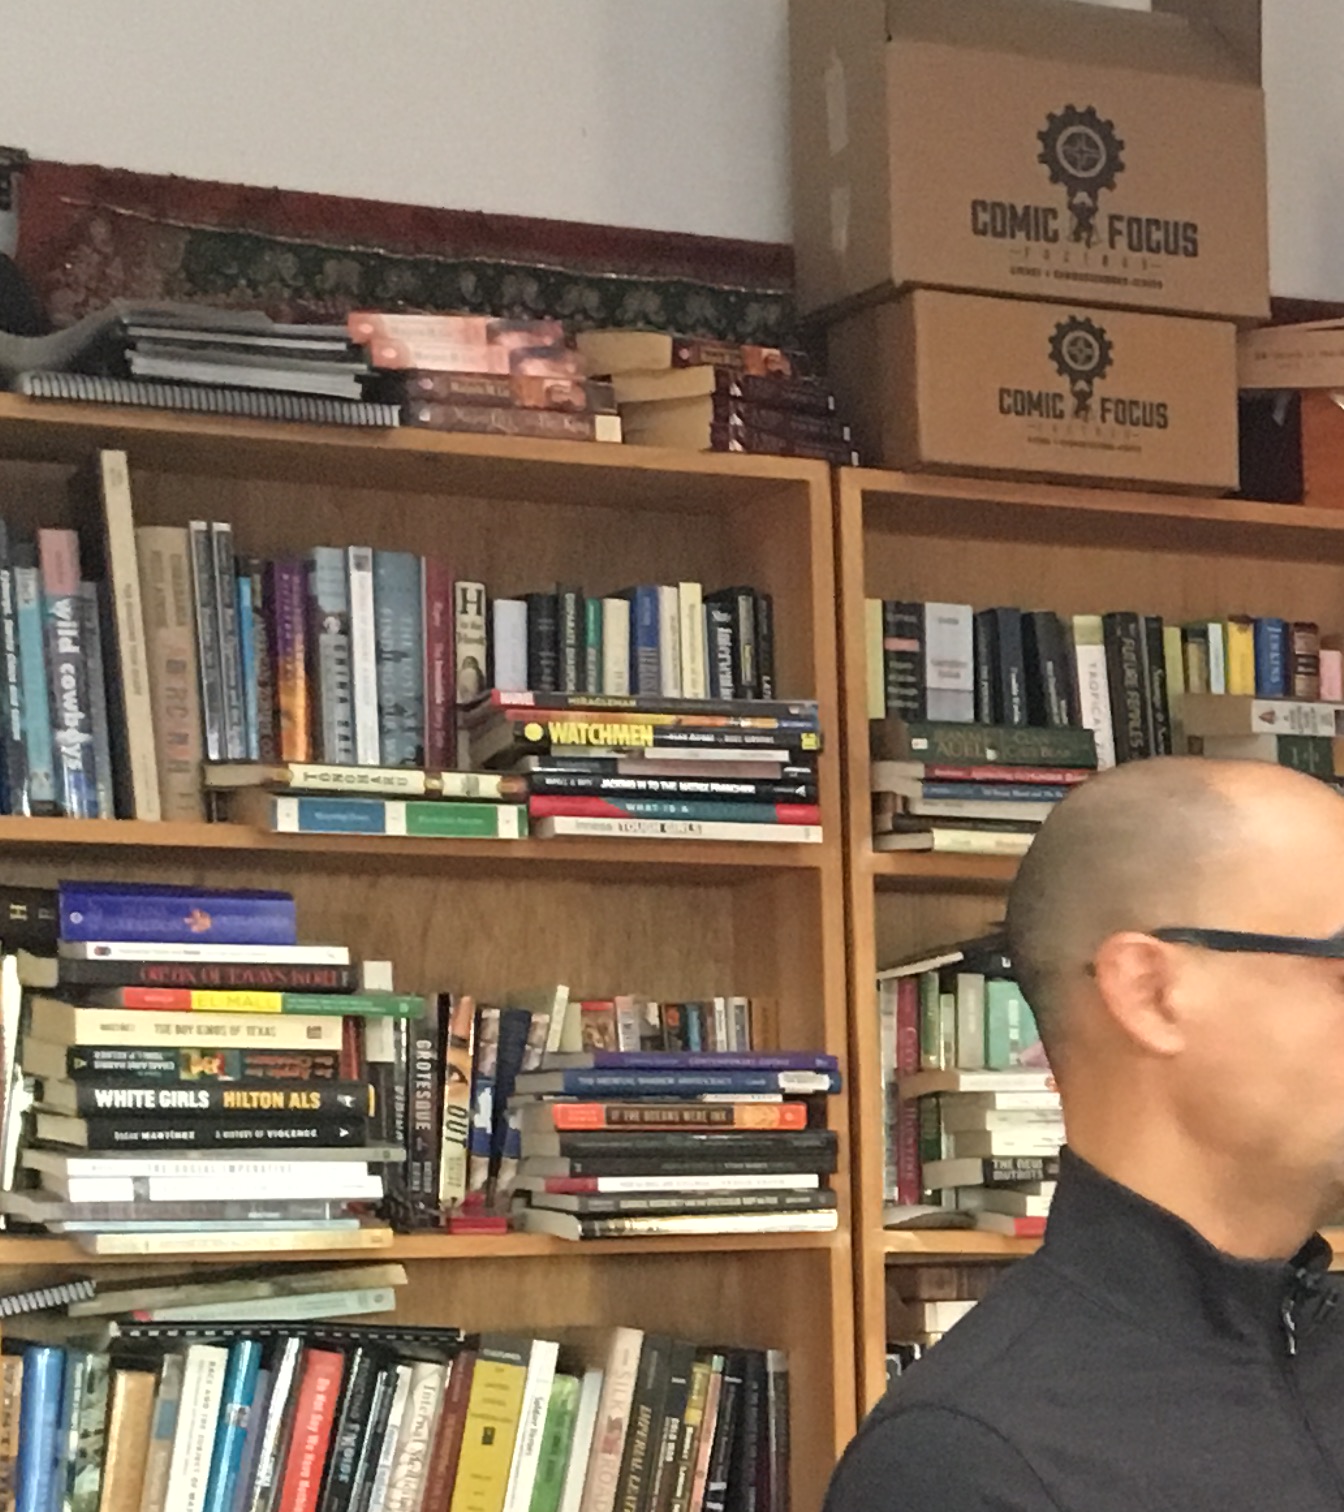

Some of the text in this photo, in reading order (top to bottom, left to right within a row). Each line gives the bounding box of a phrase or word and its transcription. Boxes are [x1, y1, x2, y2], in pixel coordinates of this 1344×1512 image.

[970, 198, 1199, 258] COMIC FOCUS
[998, 387, 1169, 430] COMIC FOCUS
[51, 599, 91, 770] wild cowboys
[549, 722, 653, 747] WATCHMEN
[416, 1039, 432, 1131] GROTESQUE
[94, 1088, 321, 1109] WHITE GIRLS HILTON ALS
[445, 1105, 468, 1149] OUT
[623, 1108, 641, 1120] THE
[317, 1377, 331, 1390] Do
[313, 1392, 326, 1409] Not
[307, 1410, 324, 1432] Say
[305, 1433, 319, 1449] We
[594, 1369, 631, 1512] SILK ROAD
[629, 1404, 652, 1472] IMPERIAL
[302, 1451, 316, 1477] Have
